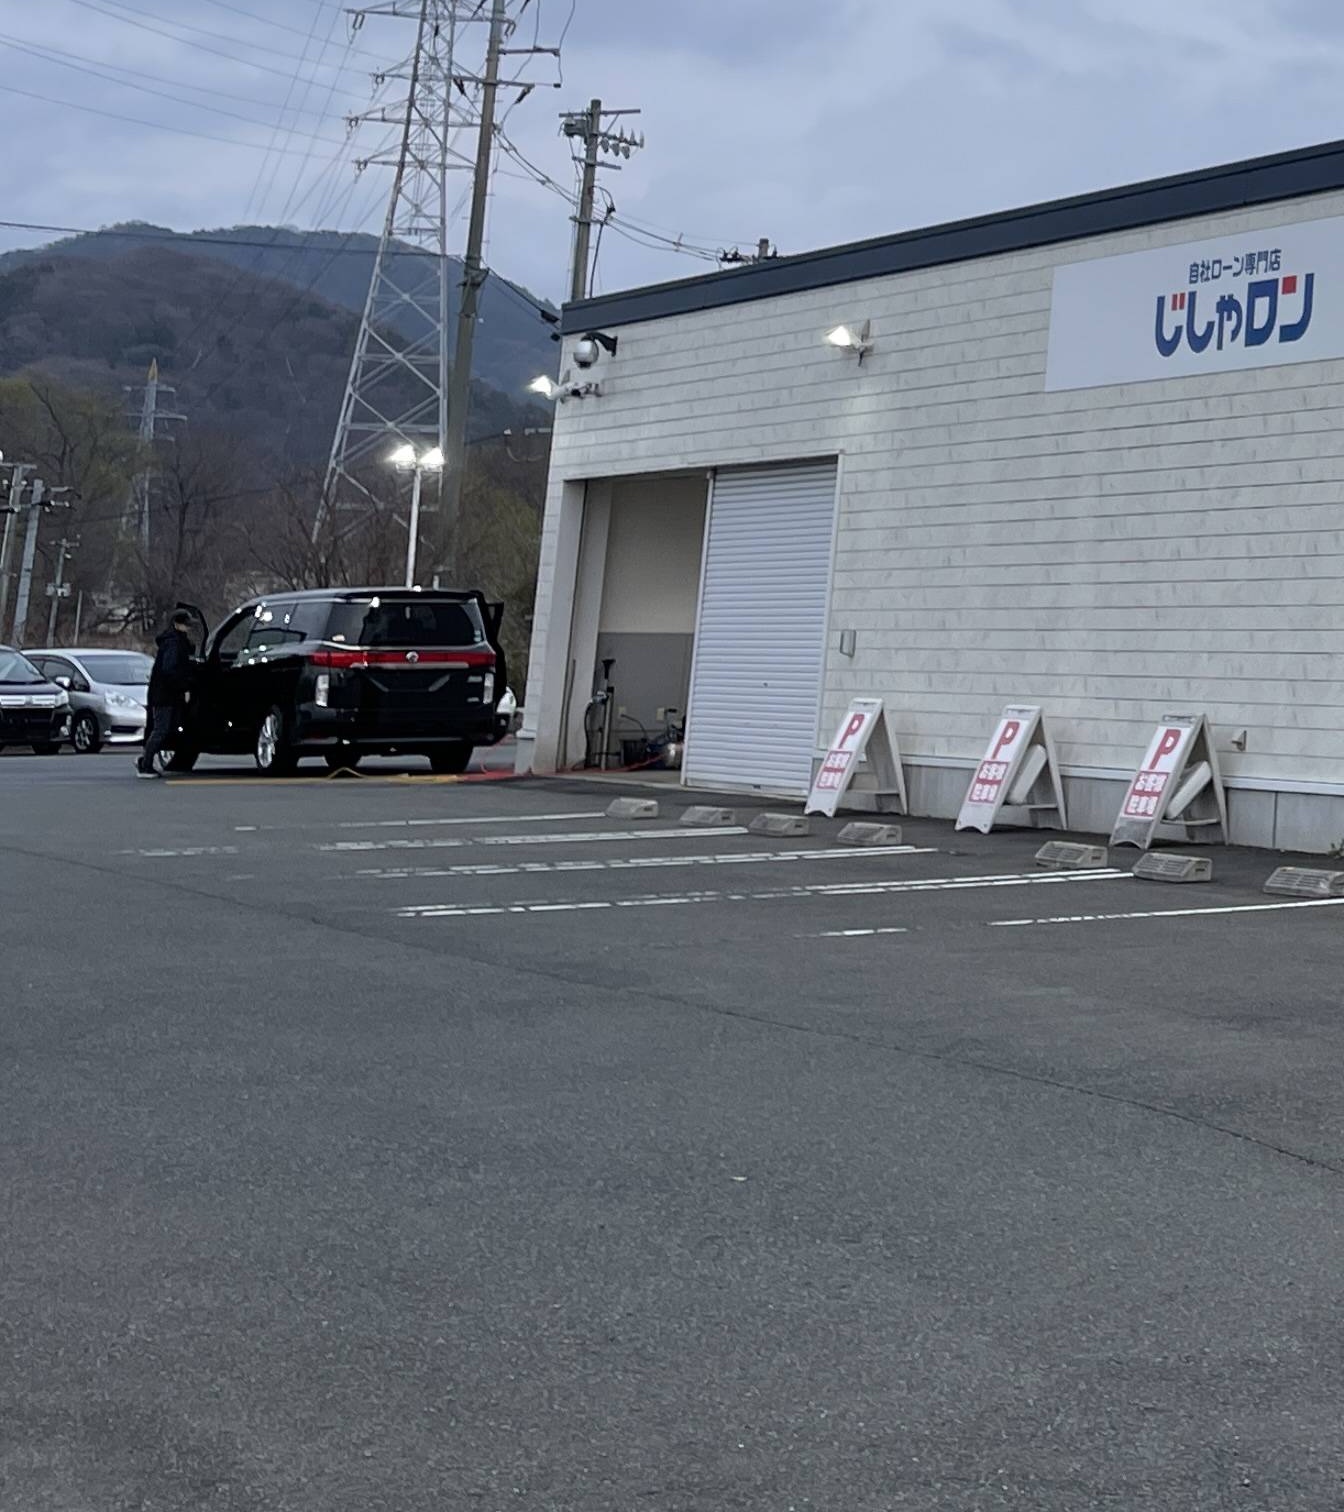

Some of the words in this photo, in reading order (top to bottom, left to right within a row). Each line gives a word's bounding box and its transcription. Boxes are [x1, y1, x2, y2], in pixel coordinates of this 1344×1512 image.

[1188, 248, 1282, 285] 自社ローン専門店
[1154, 272, 1315, 358] じしゃロン
[838, 713, 866, 749] P
[991, 720, 1021, 760] P
[1149, 728, 1182, 770] P
